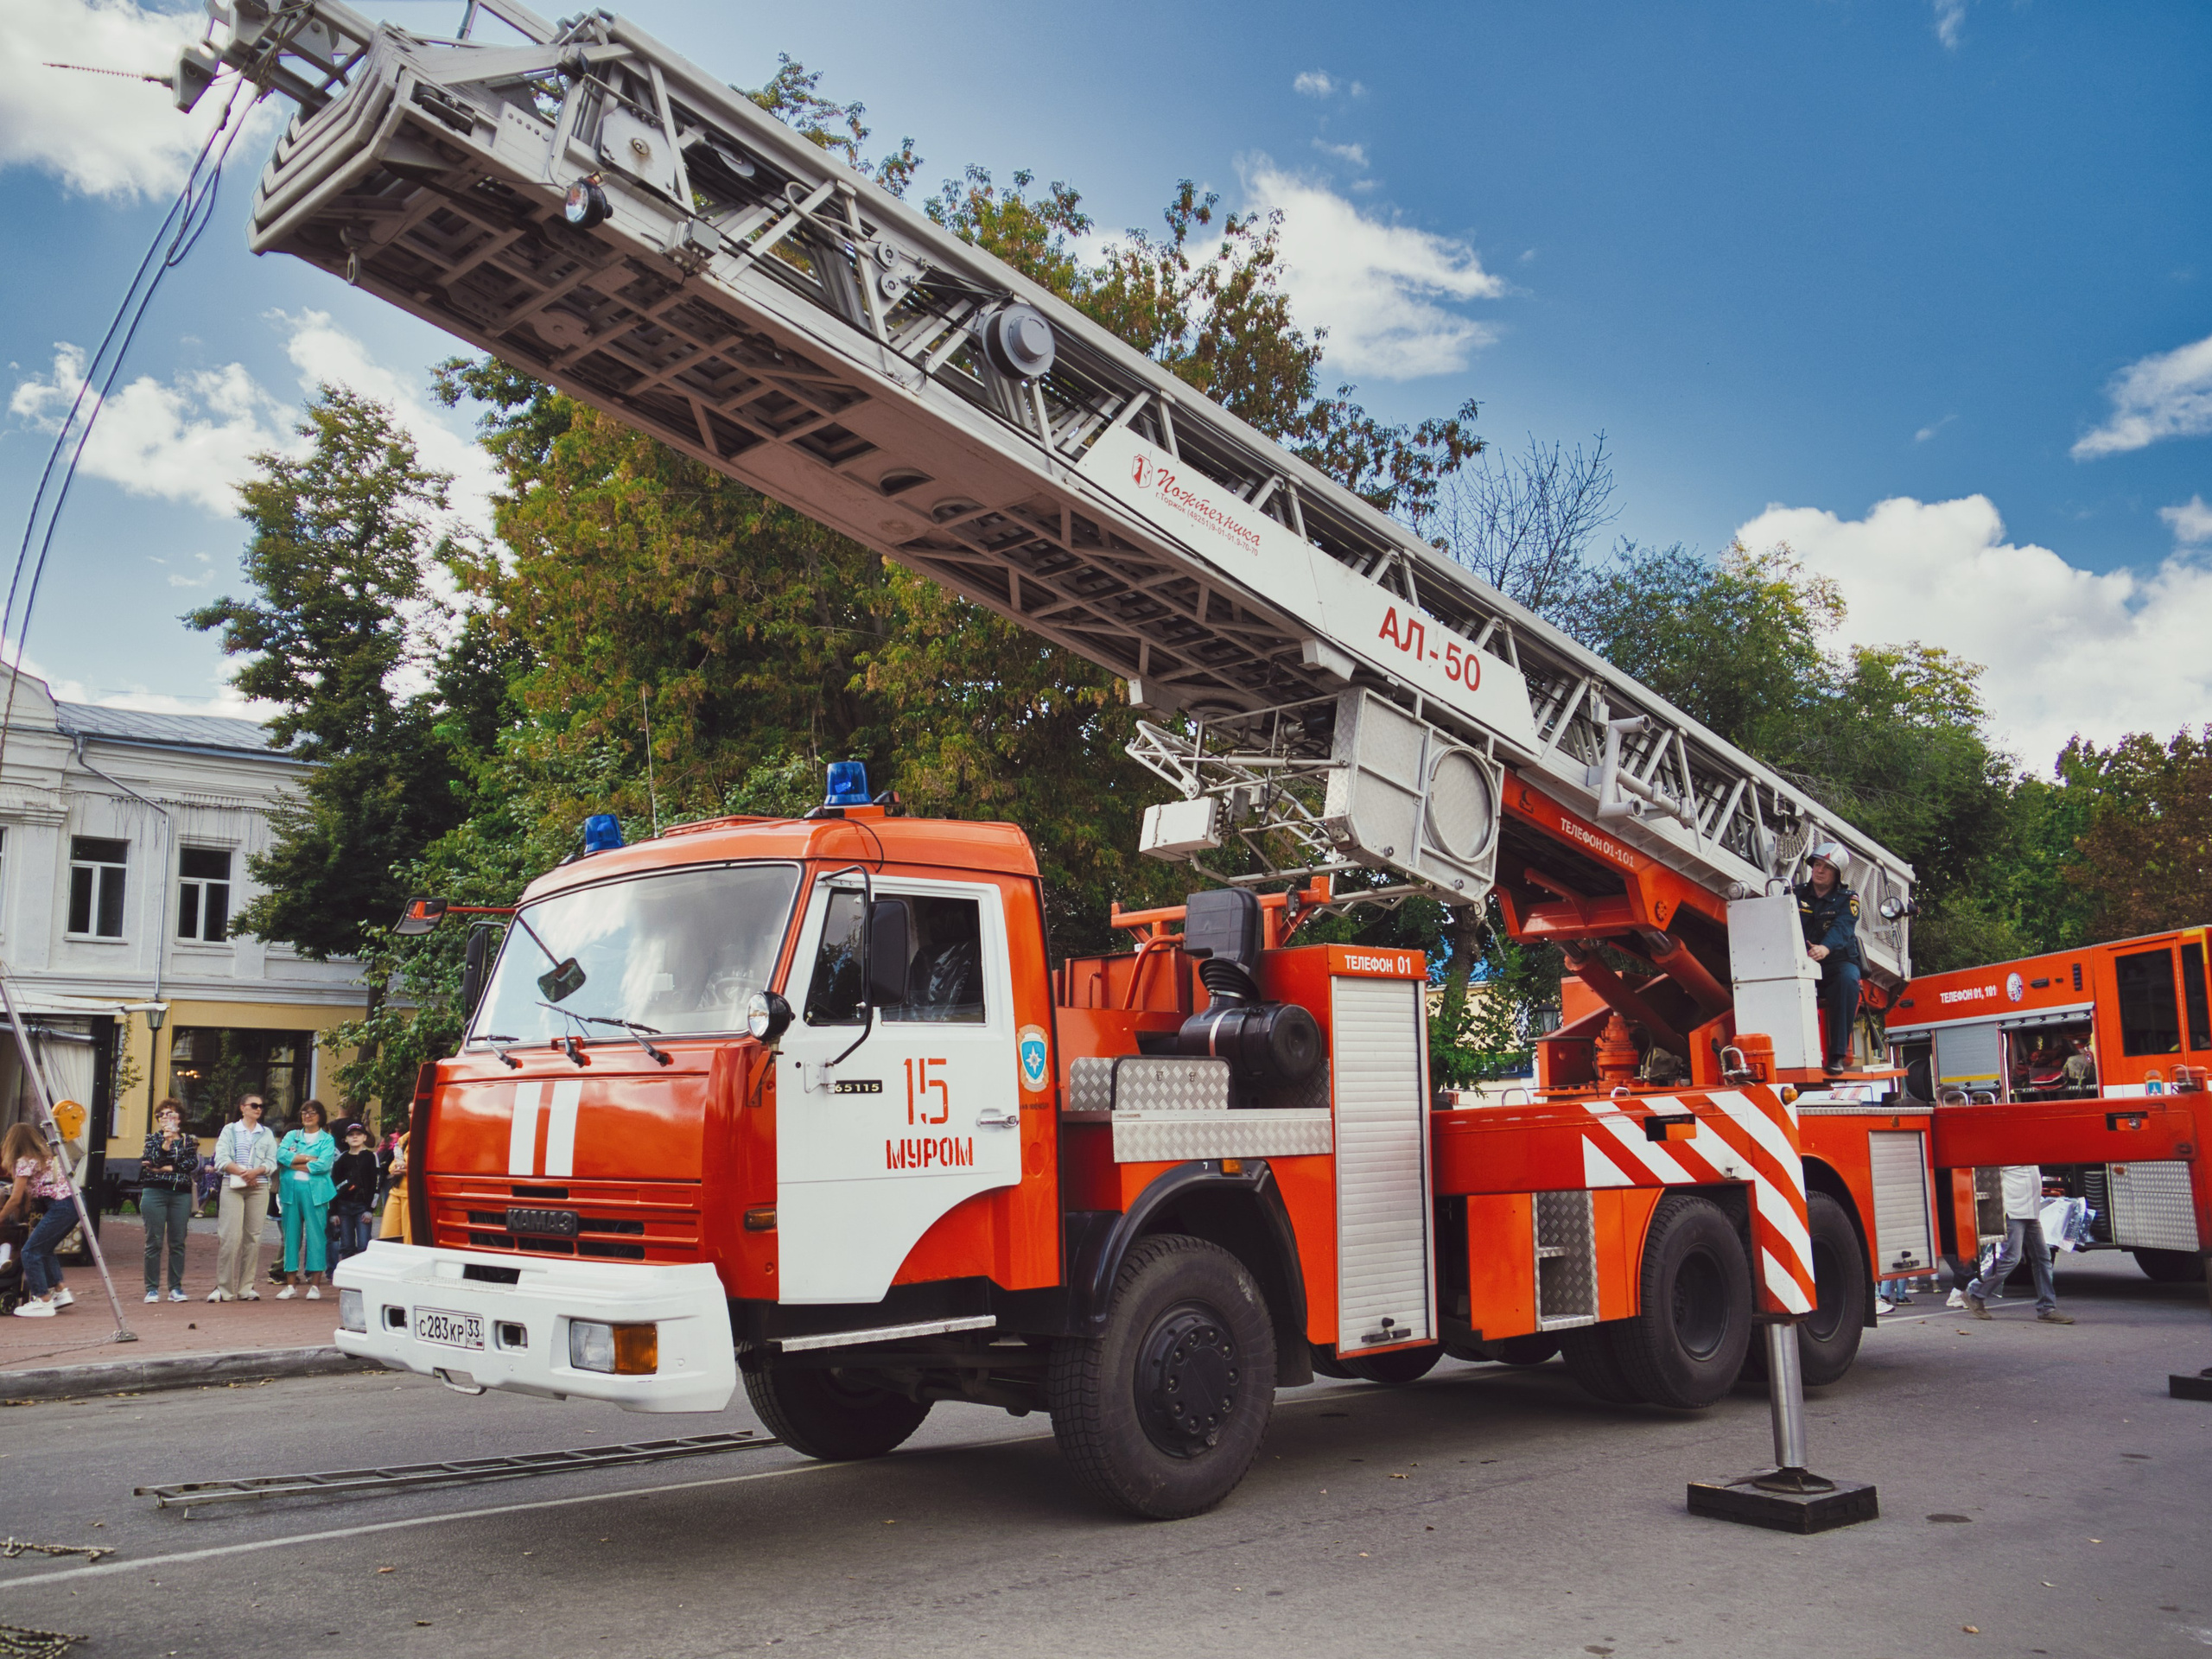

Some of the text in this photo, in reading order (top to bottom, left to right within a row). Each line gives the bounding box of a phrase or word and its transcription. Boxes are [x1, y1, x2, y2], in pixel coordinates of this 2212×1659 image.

[1157, 467, 1262, 546] Пожтехника
[1560, 817, 1603, 851] ТЕЛЕФОН
[1344, 954, 1411, 975] ТЕЛЕФОН 01
[1940, 988, 1973, 1003] ТЕЛЕФОН
[1984, 984, 1997, 997] 101
[835, 1083, 880, 1092] 65115
[903, 1058, 949, 1125] 15
[886, 1137, 974, 1170] МУРОМ
[506, 1209, 573, 1235] КАМАЗ
[467, 1319, 480, 1338] 33
